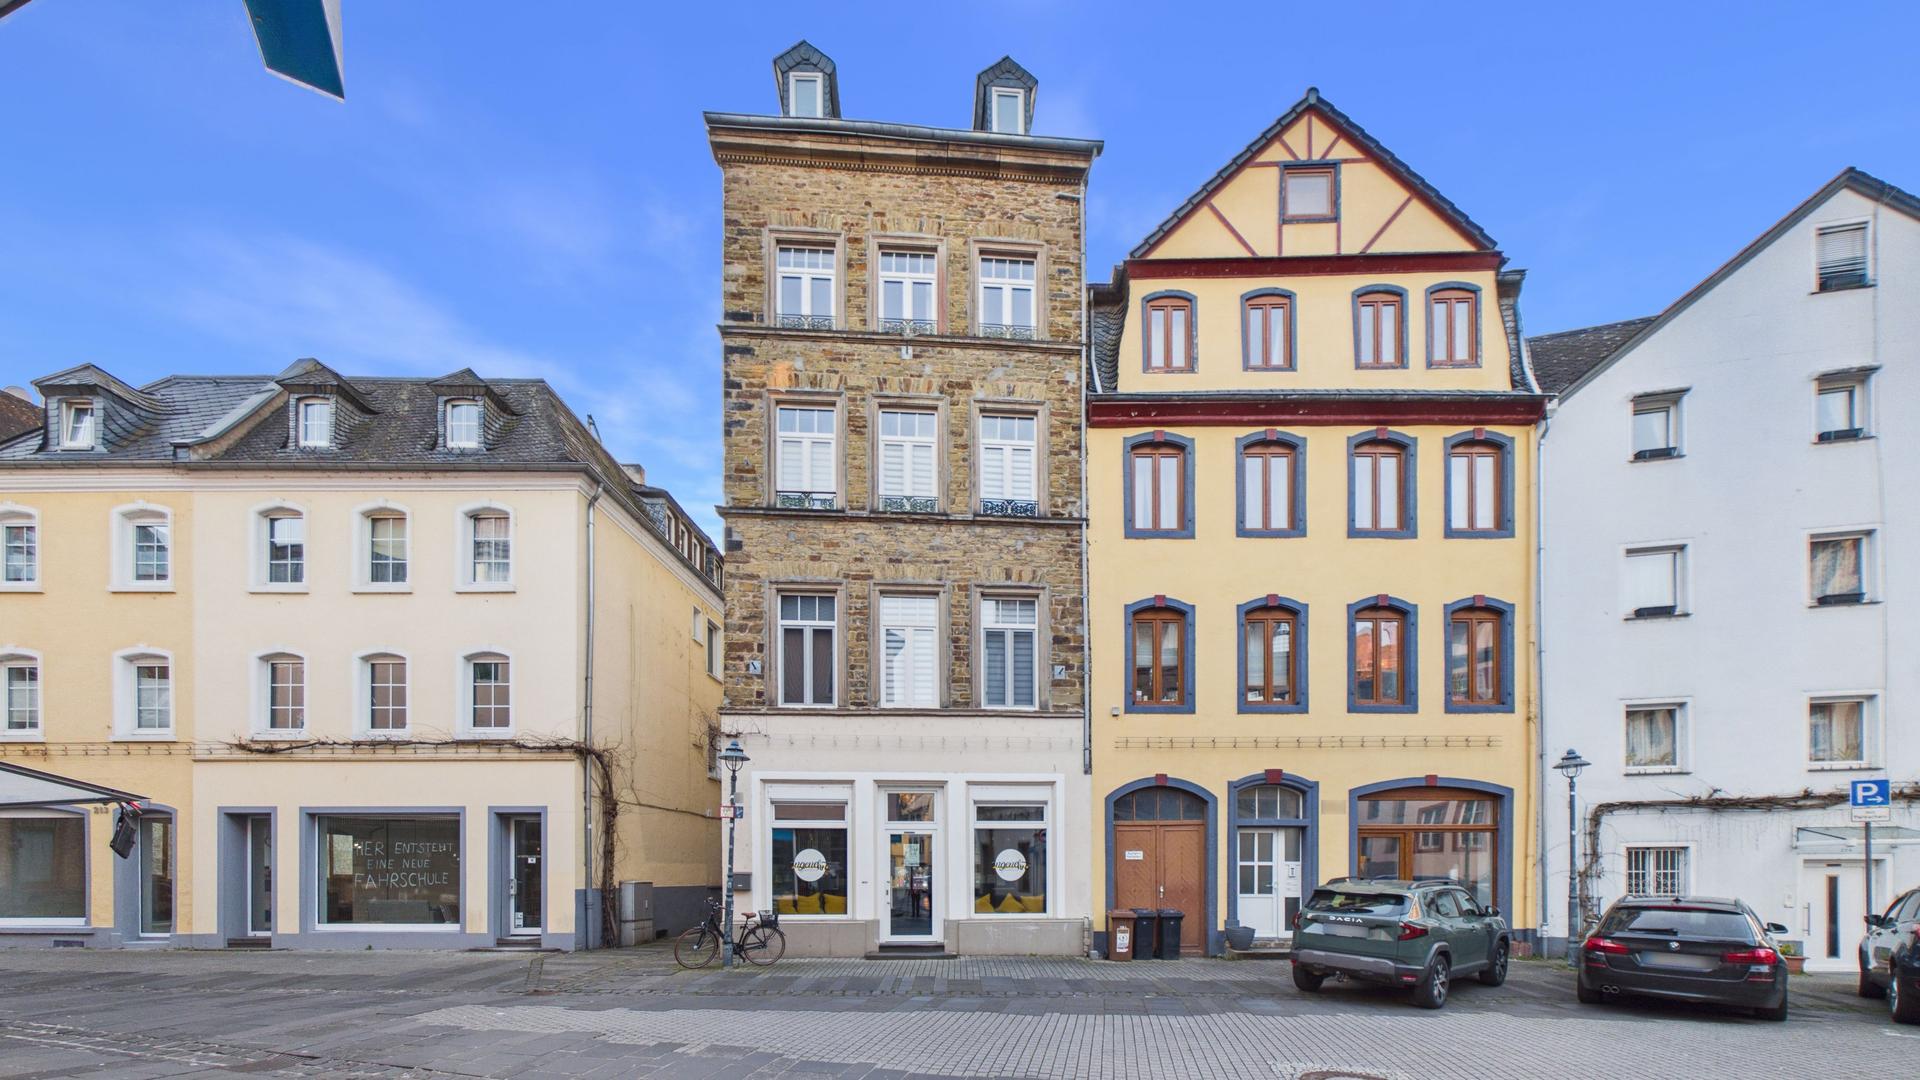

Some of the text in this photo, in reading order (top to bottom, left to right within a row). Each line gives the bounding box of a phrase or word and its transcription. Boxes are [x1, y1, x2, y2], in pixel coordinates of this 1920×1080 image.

[1857, 783, 1878, 804] P
[394, 841, 453, 855] ENTSTEHT
[367, 858, 431, 870] EINE NEUE
[353, 872, 449, 890] FAHRSCHULE
[1328, 915, 1363, 923] DACIA
